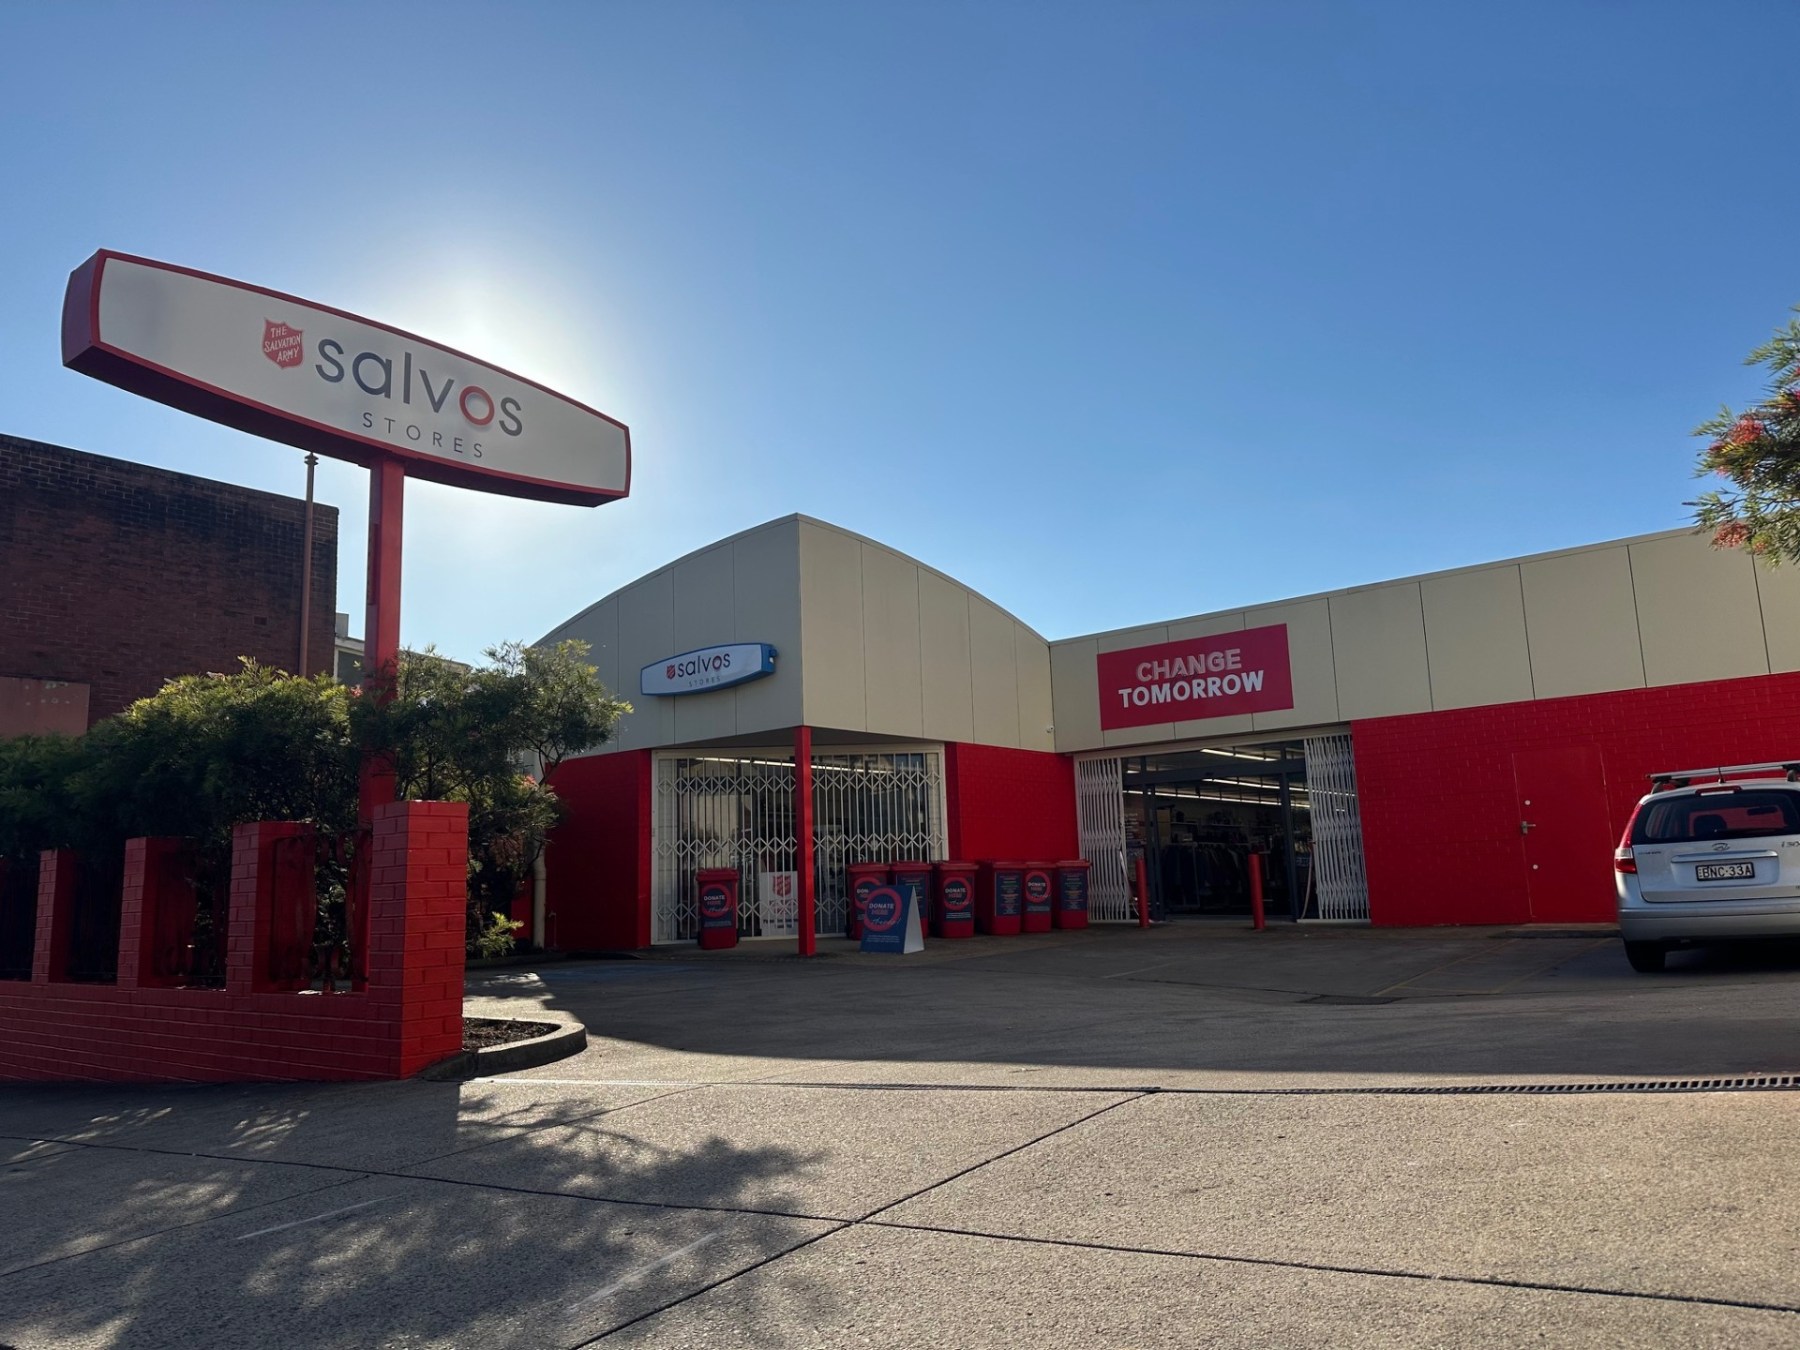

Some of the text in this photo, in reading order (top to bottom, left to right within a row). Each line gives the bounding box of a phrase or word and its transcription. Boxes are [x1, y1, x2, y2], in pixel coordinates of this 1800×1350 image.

[264, 333, 301, 353] SALVATION
[271, 326, 287, 338] THE
[277, 346, 300, 362] ARMY
[315, 338, 523, 437] salvos
[362, 411, 483, 458] STORES
[677, 653, 731, 678] salvos
[1136, 648, 1242, 682] CHANGE
[1118, 670, 1264, 708] TOMORROW
